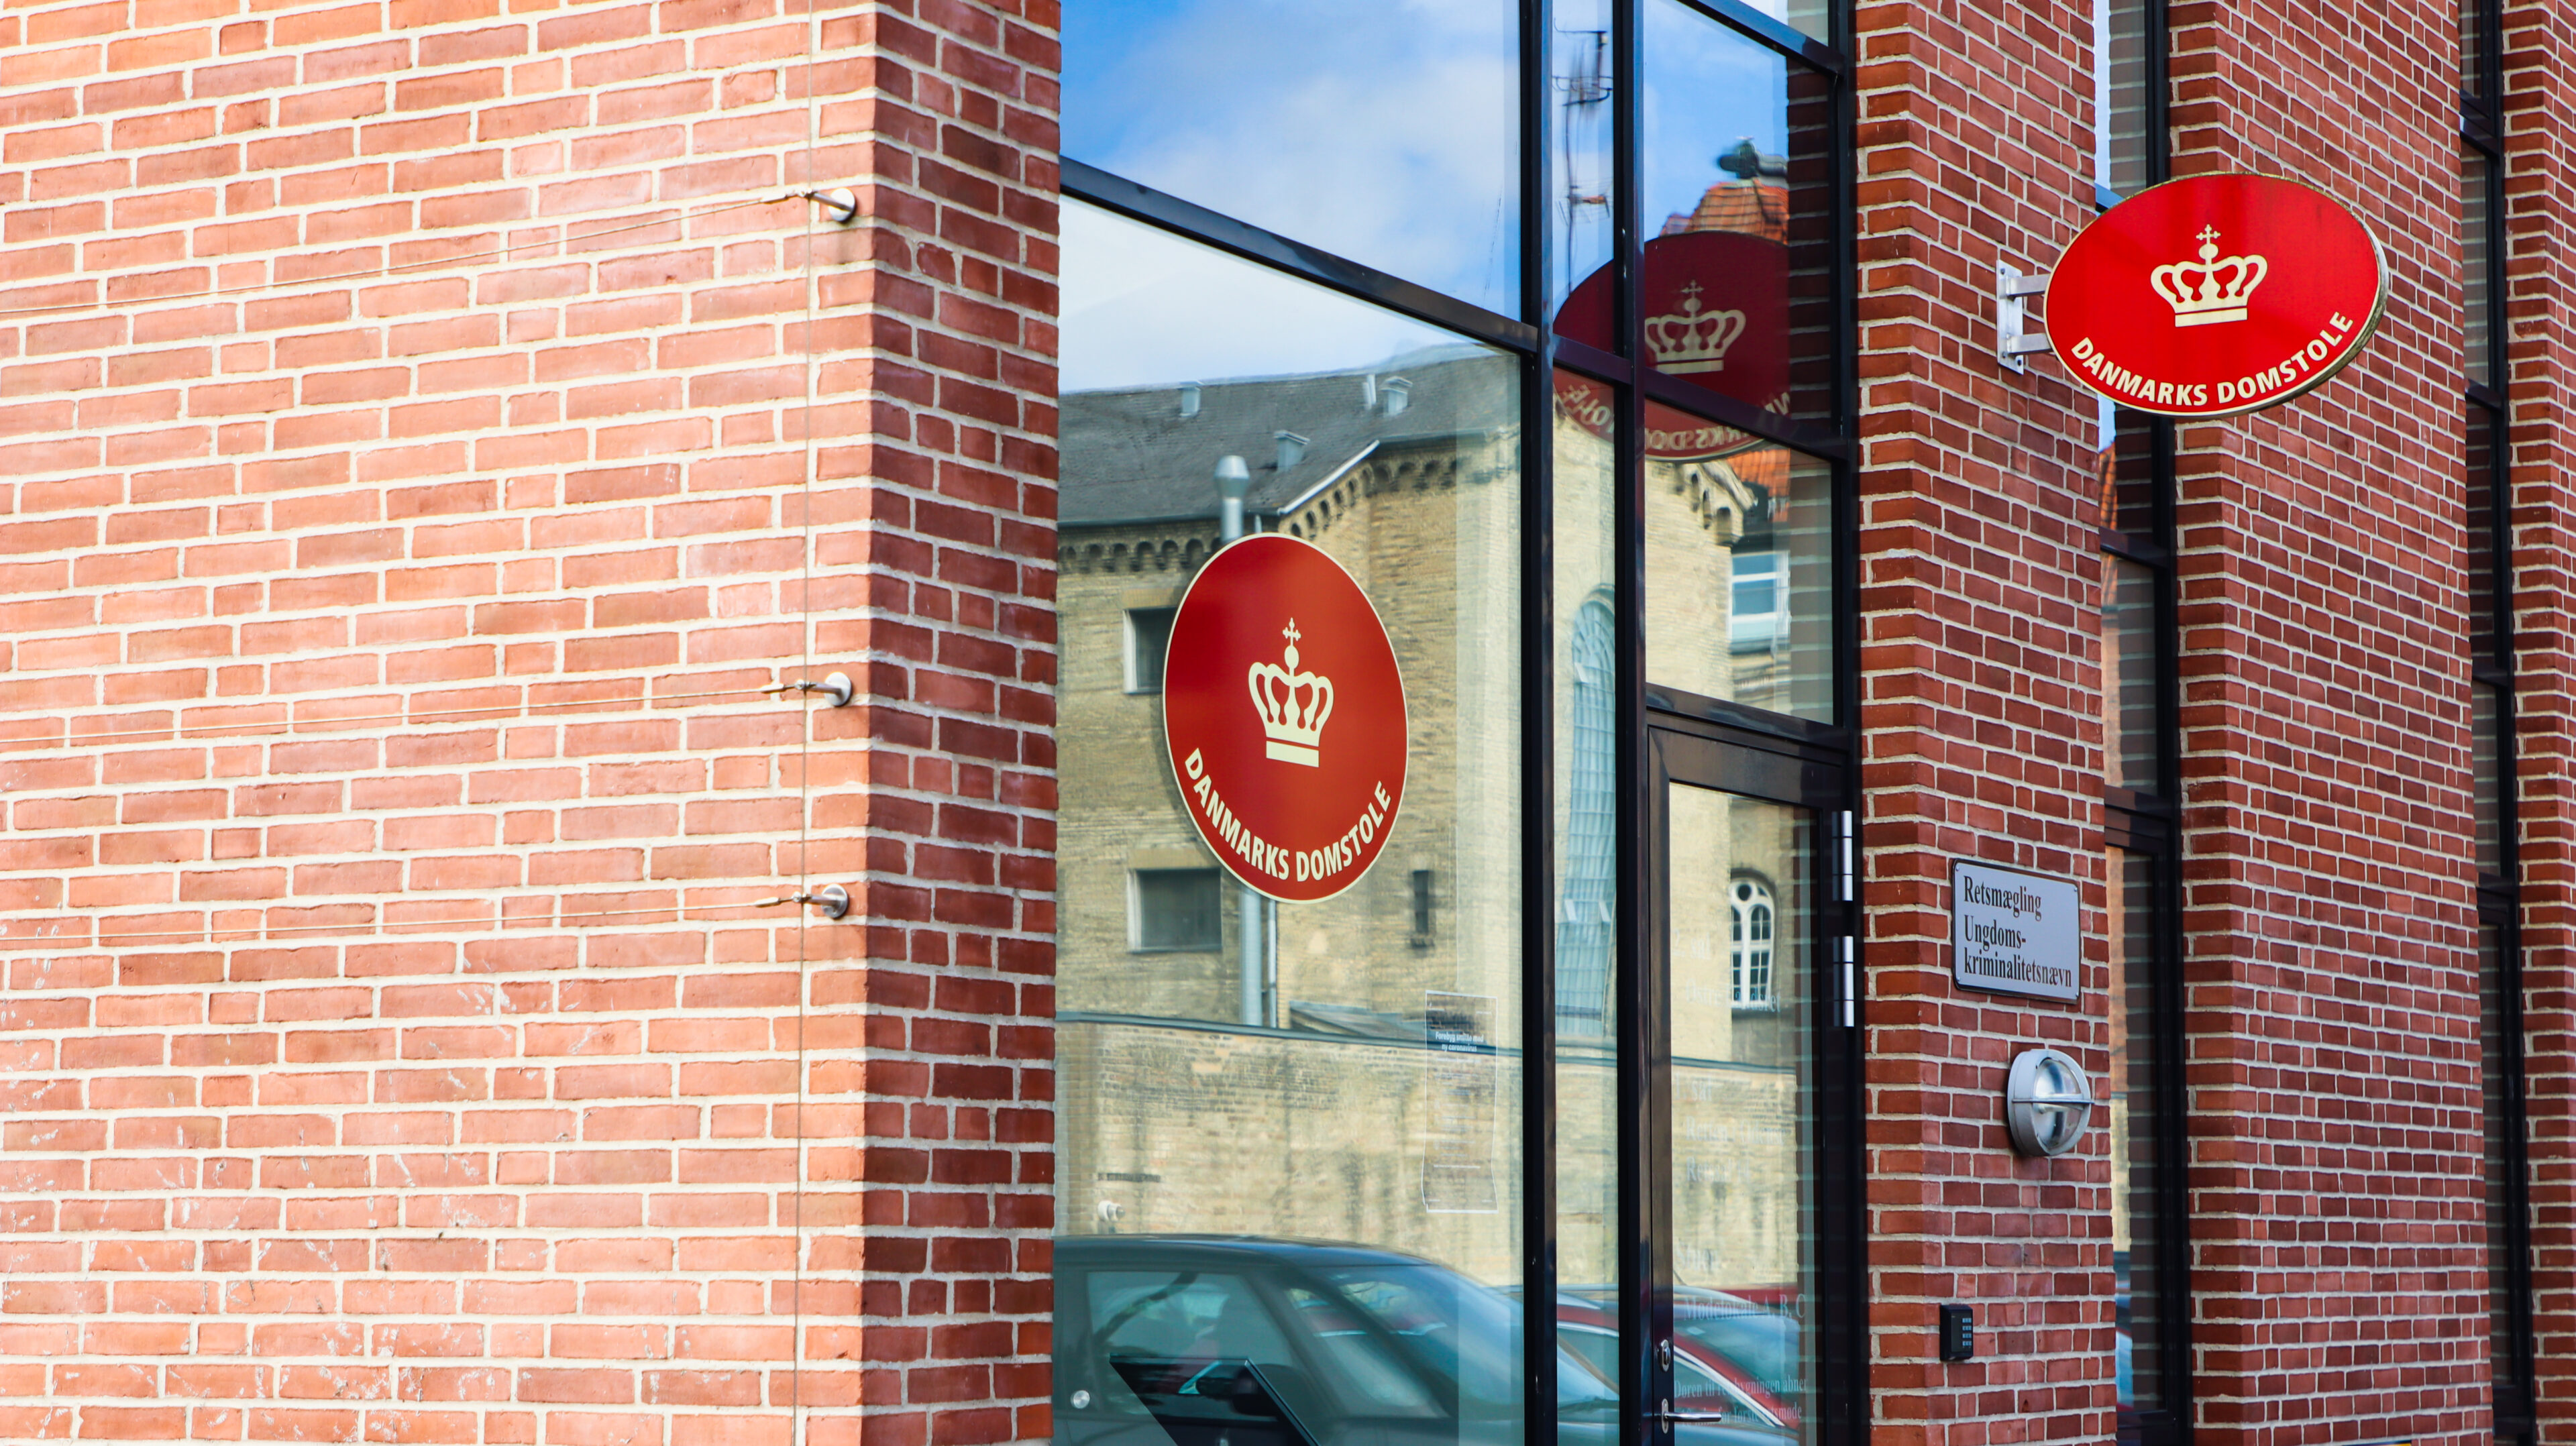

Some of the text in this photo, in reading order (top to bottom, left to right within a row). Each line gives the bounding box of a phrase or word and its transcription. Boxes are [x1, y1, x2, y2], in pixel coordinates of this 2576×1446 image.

[2071, 311, 2354, 406] DANMARKS DOMSTOLE
[1185, 747, 1391, 883] DANMARKS DOMSTOLE
[1964, 875, 2042, 922] Retsmægling
[1964, 914, 2027, 952] Ungdoms-
[1964, 947, 2072, 988] kriminalitetsnævn
[1436, 1031, 1484, 1043] Forebyg smitte med
[1442, 1043, 1477, 1052] ny coronavirus
